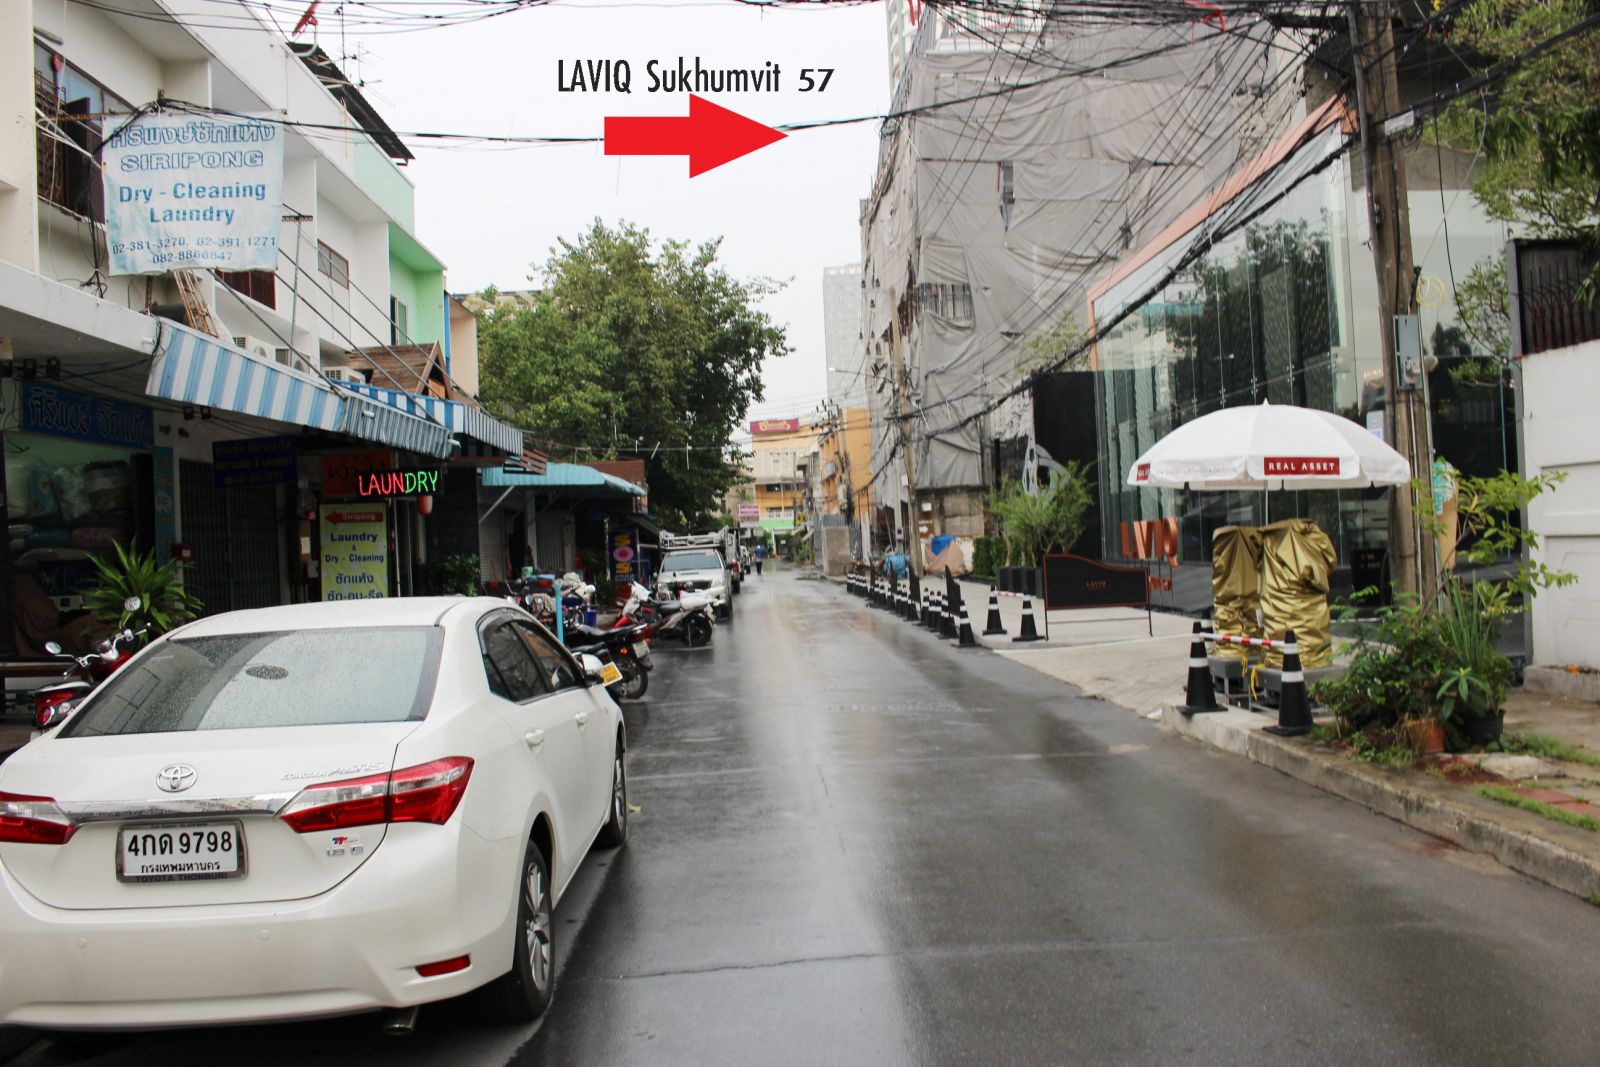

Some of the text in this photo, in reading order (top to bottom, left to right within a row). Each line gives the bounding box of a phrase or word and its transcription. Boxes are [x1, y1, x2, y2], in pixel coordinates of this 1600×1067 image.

[120, 150, 264, 172] SIRIPONG
[119, 185, 153, 204] Dry
[172, 181, 266, 201] Cleaning
[149, 206, 235, 225] Laundry
[1268, 462, 1336, 471] REAL ASSET
[358, 470, 438, 497] LAUNDRY
[330, 532, 378, 544] Laundry
[325, 554, 339, 564] Dry
[348, 553, 384, 563] Cleaning
[127, 831, 232, 856] 4กด 9798
[141, 861, 221, 874] กรงเทพมหานคร
[136, 873, 228, 883] TOYOTA THONBURI
